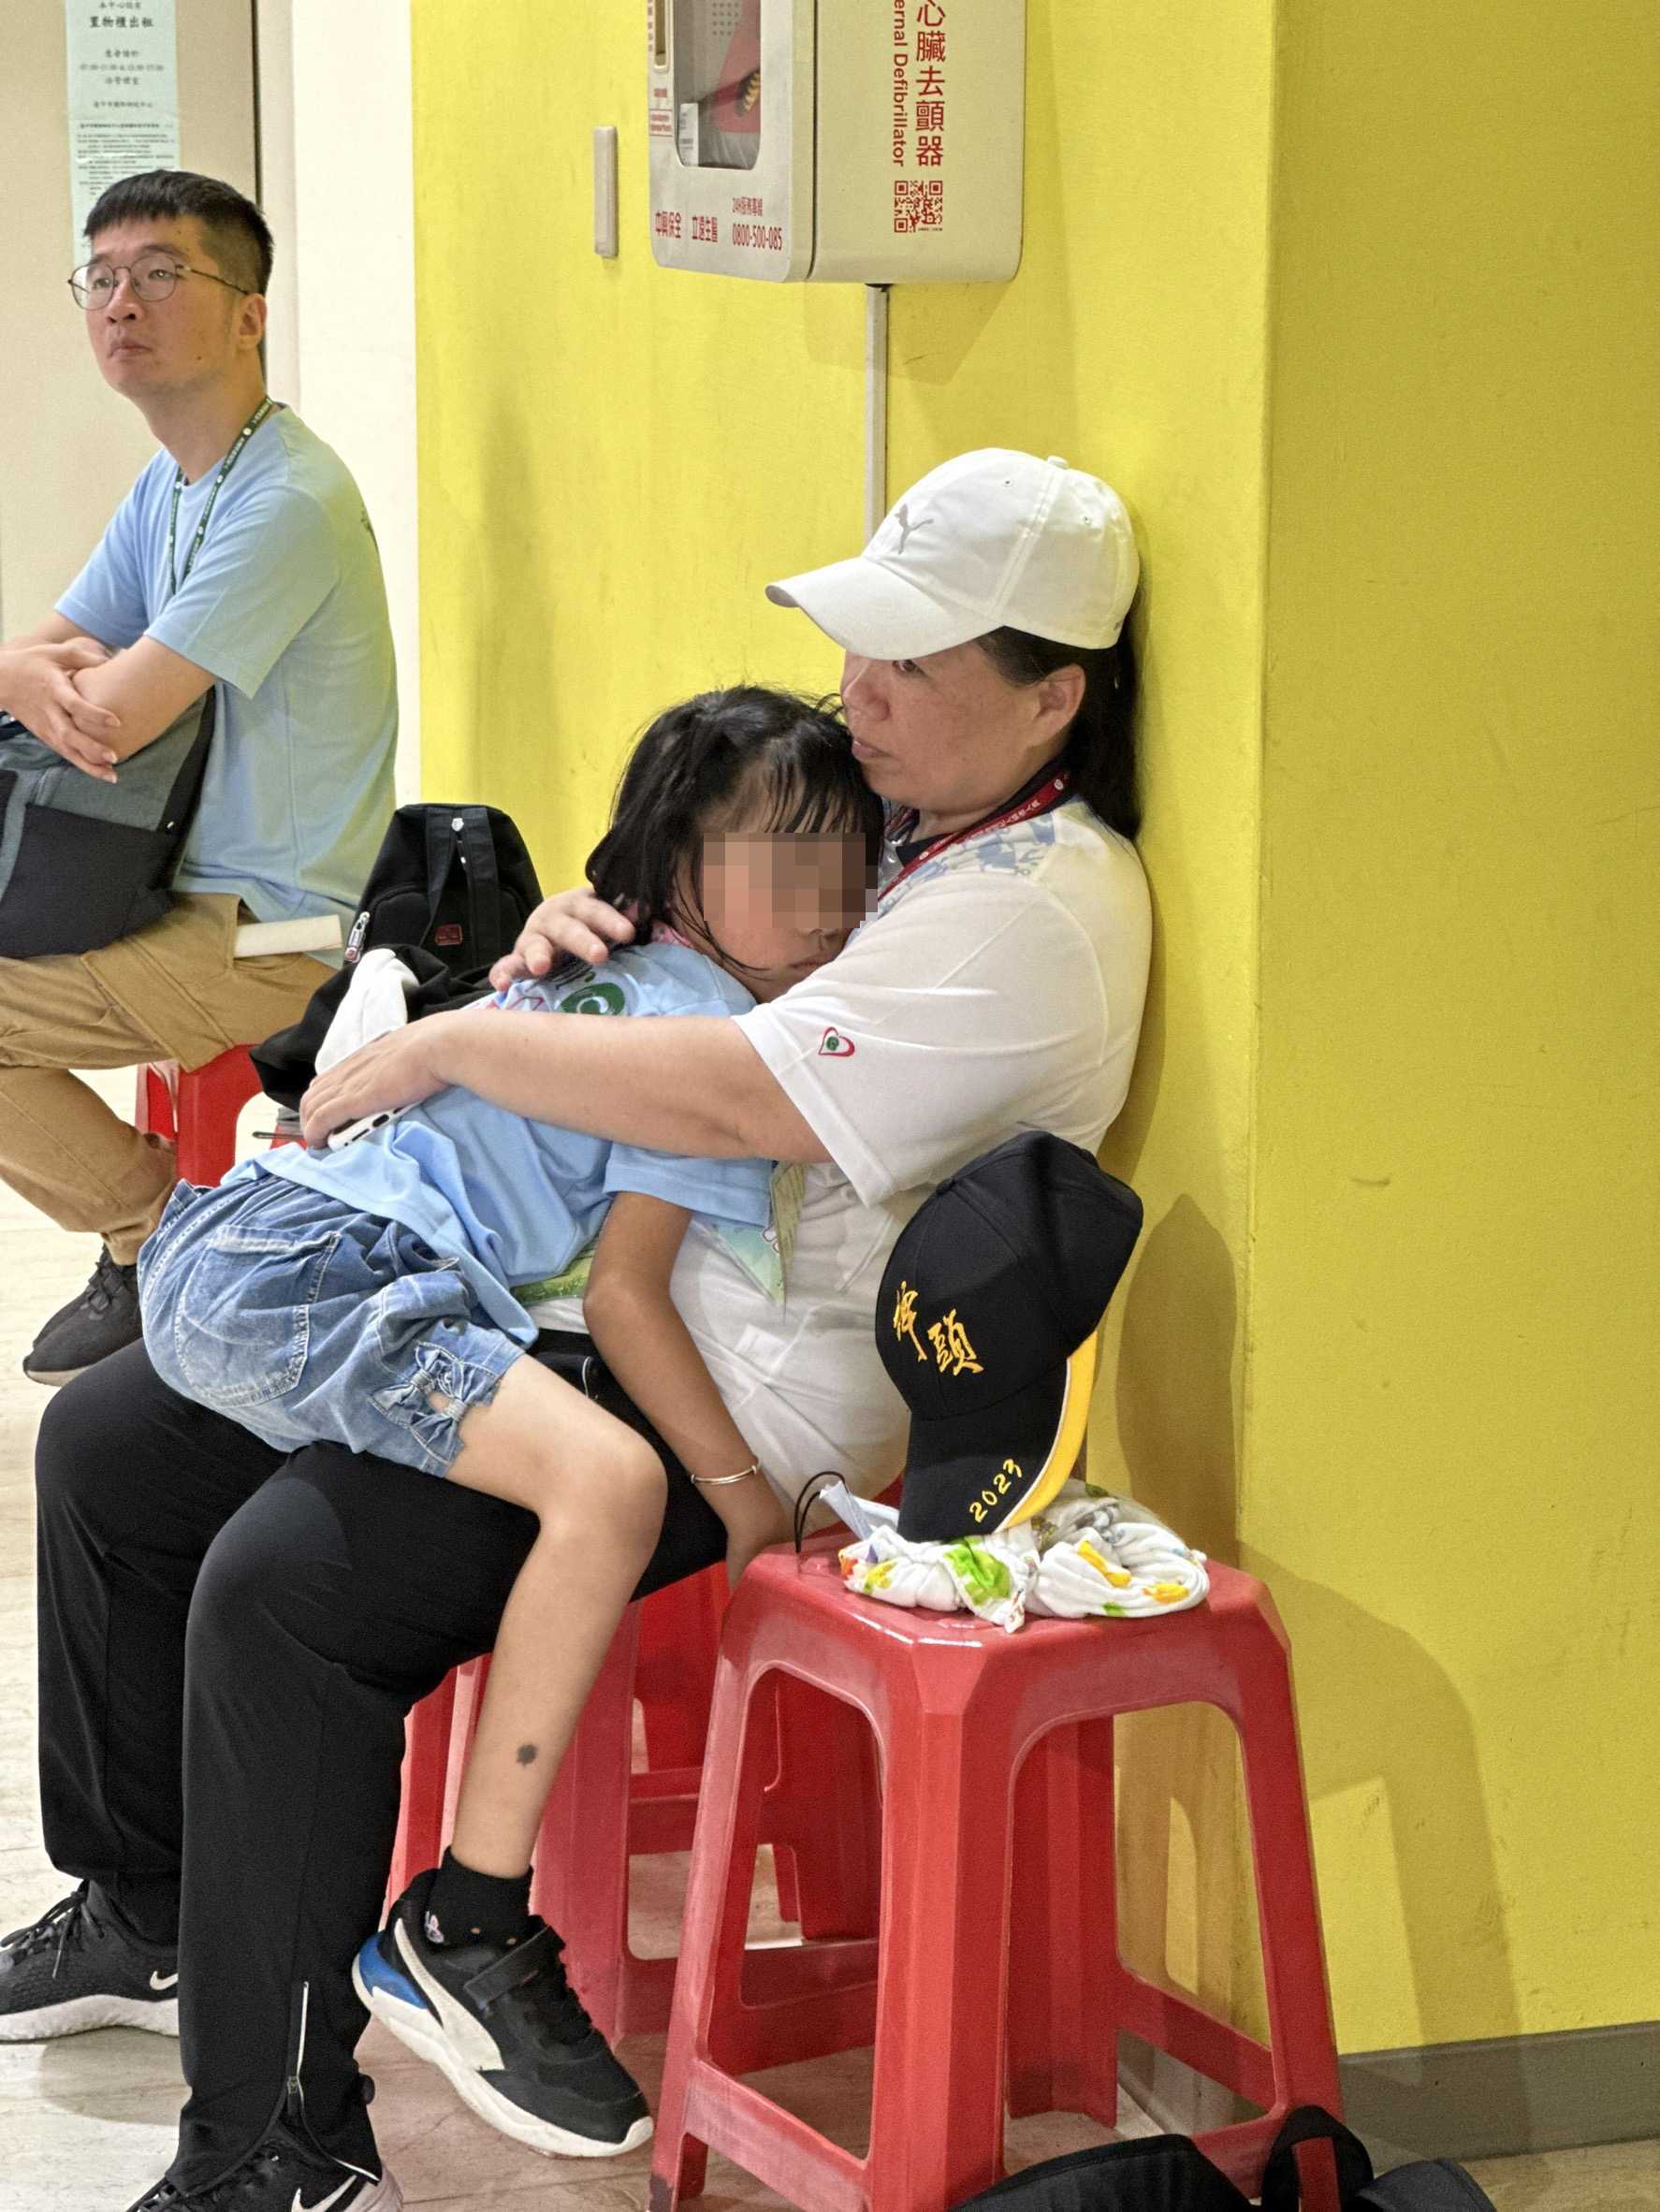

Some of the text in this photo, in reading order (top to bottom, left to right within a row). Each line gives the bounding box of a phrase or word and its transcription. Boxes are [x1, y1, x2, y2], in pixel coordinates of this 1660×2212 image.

[893, 53, 908, 166] Defibrillator
[915, 0, 946, 166] 心臟去顫器
[732, 224, 782, 251] 0800-500-085
[968, 1458, 1023, 1524] 2023
